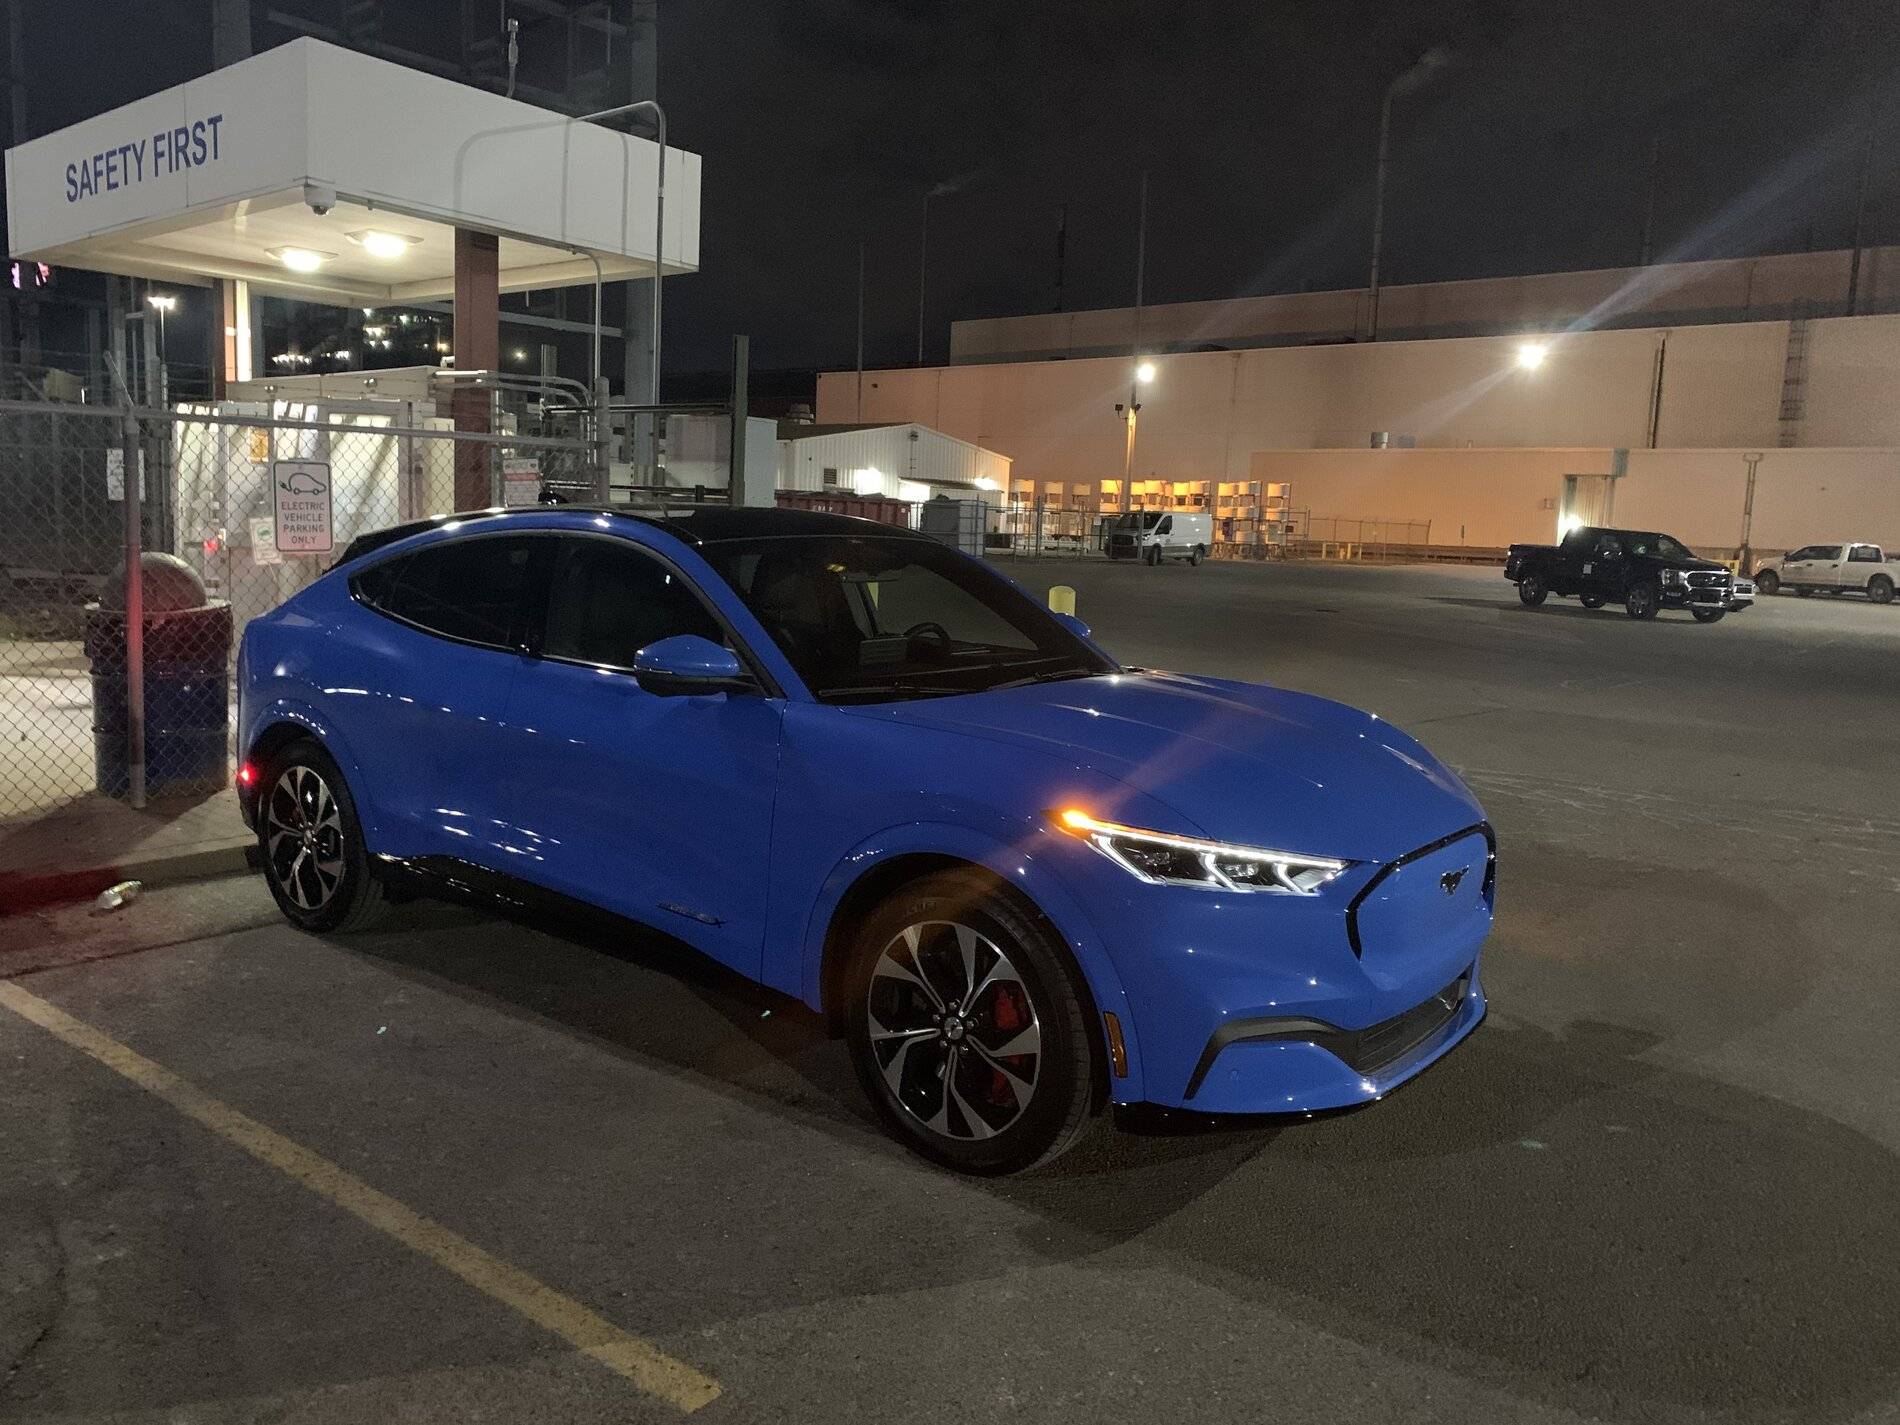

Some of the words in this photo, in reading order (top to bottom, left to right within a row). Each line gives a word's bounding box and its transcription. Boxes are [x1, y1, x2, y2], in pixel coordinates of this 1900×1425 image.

[65, 139, 146, 203] SAFETY
[153, 114, 223, 178] FIRST
[281, 501, 325, 511] ELECTRIC
[284, 513, 323, 522] VEHICLE
[283, 523, 325, 533] PARKING
[291, 536, 317, 545] ONLY
